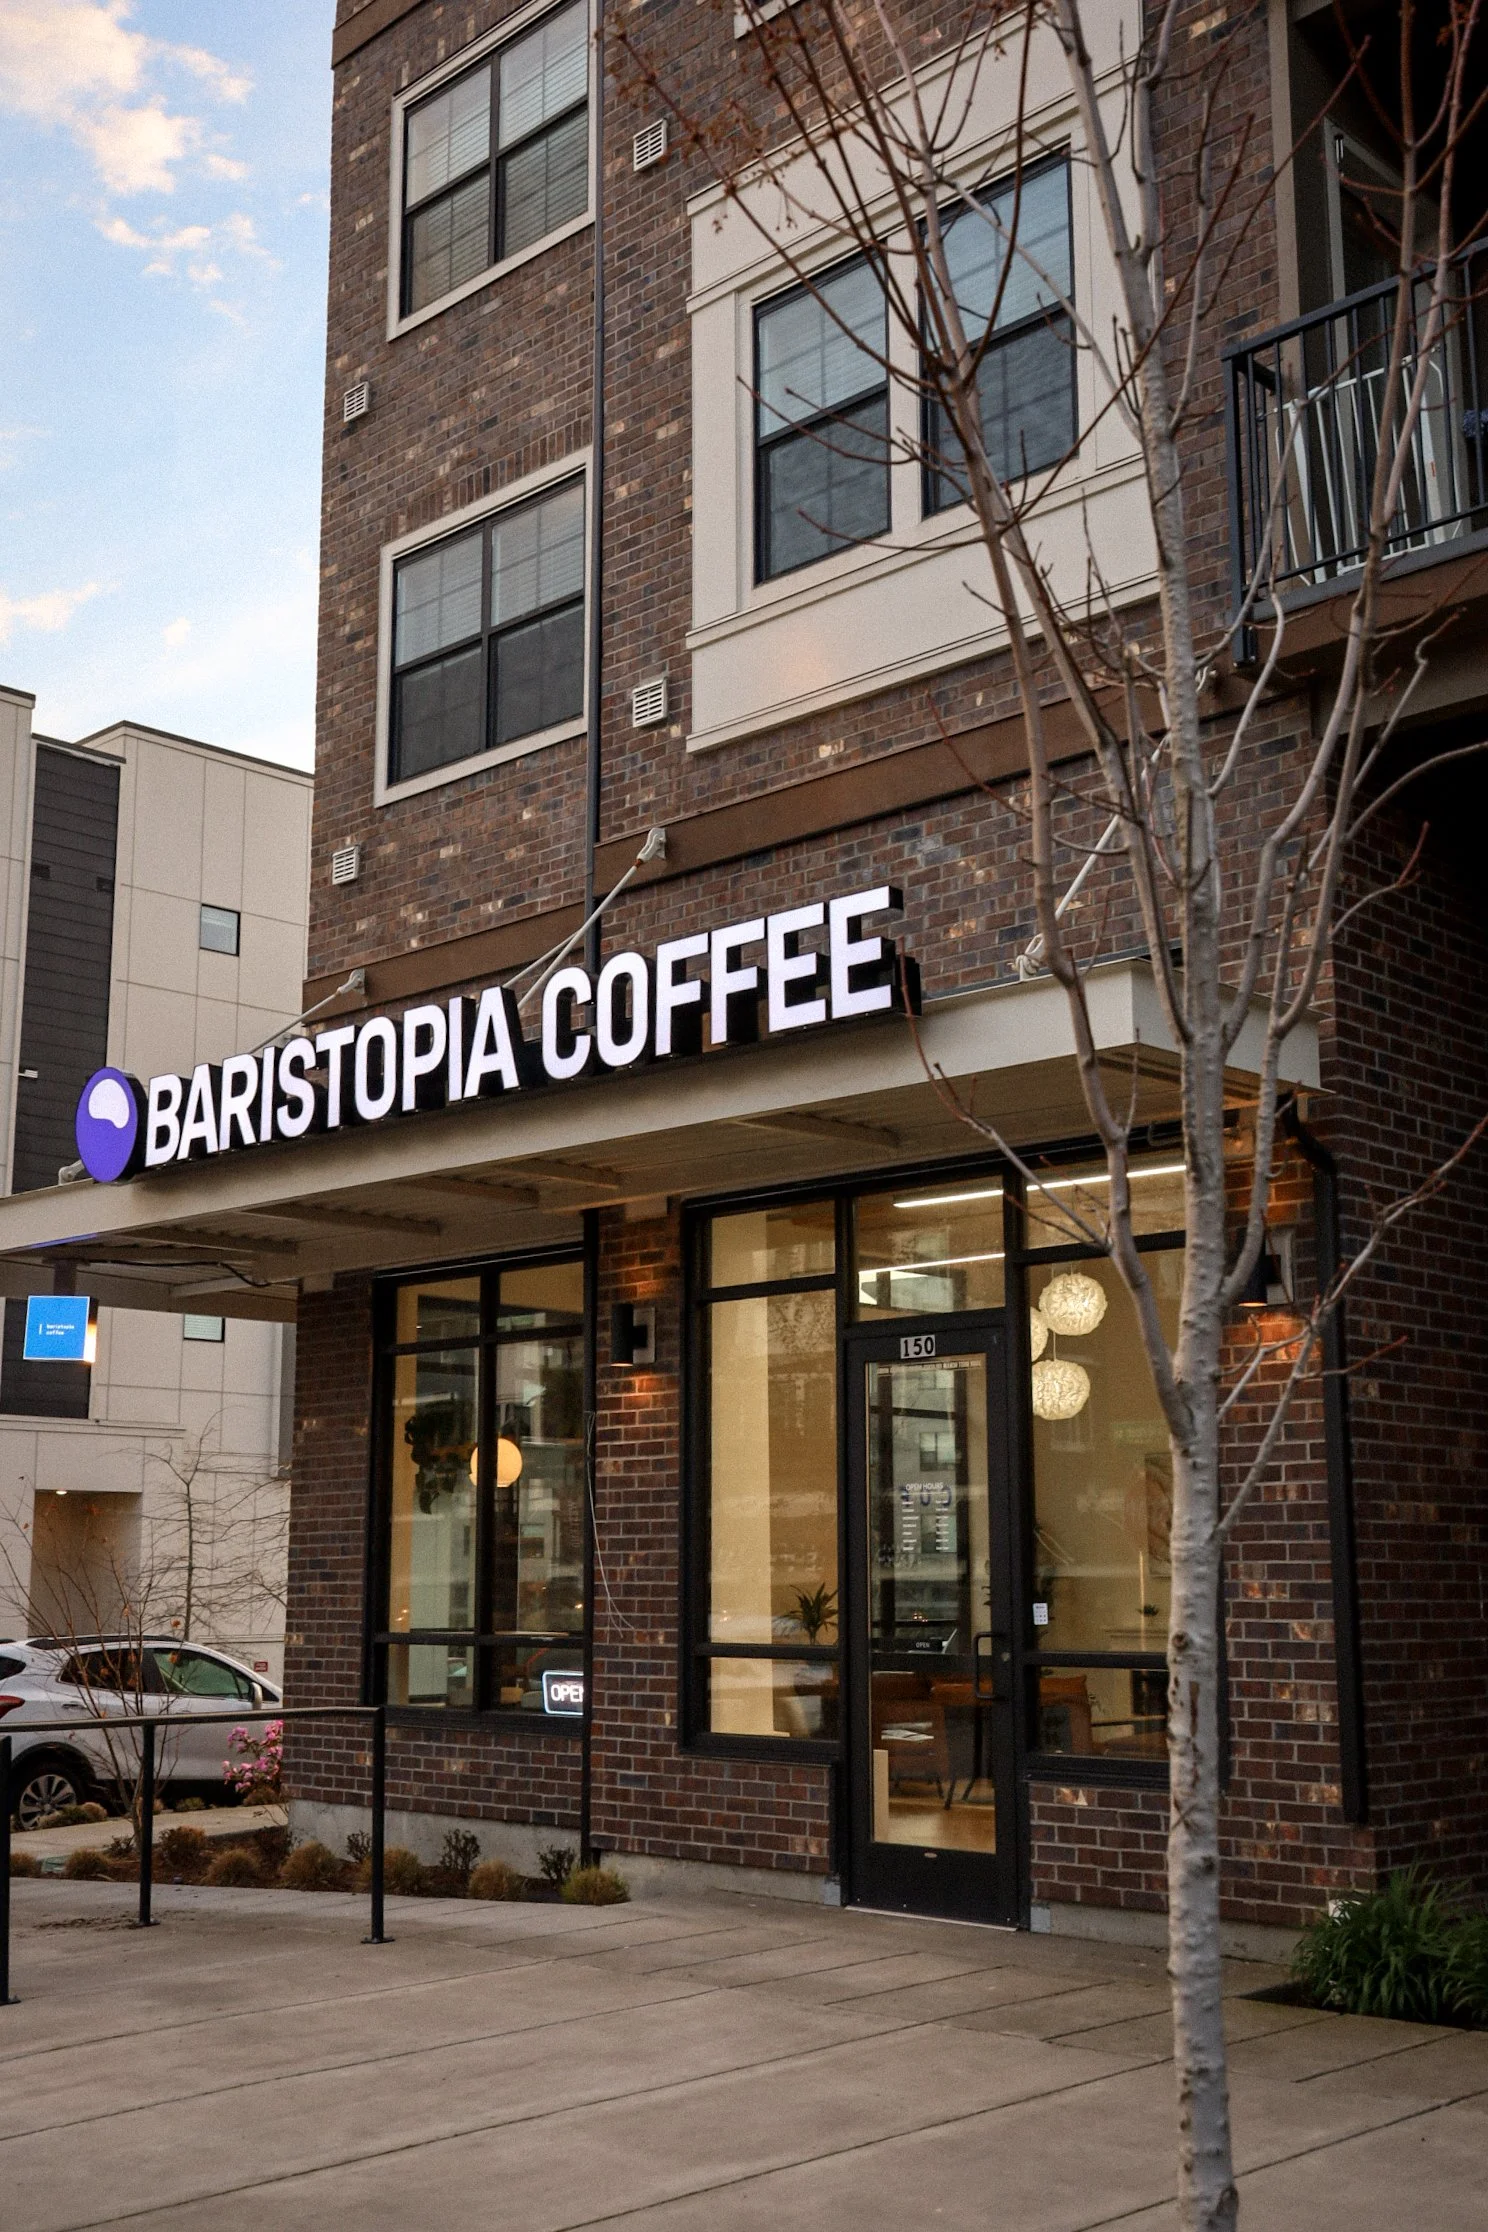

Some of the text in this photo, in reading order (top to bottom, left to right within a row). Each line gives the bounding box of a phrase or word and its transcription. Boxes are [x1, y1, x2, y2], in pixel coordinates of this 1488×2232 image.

[145, 885, 892, 1167] BARISTOPIA COFFEE
[903, 1336, 934, 1357] 150
